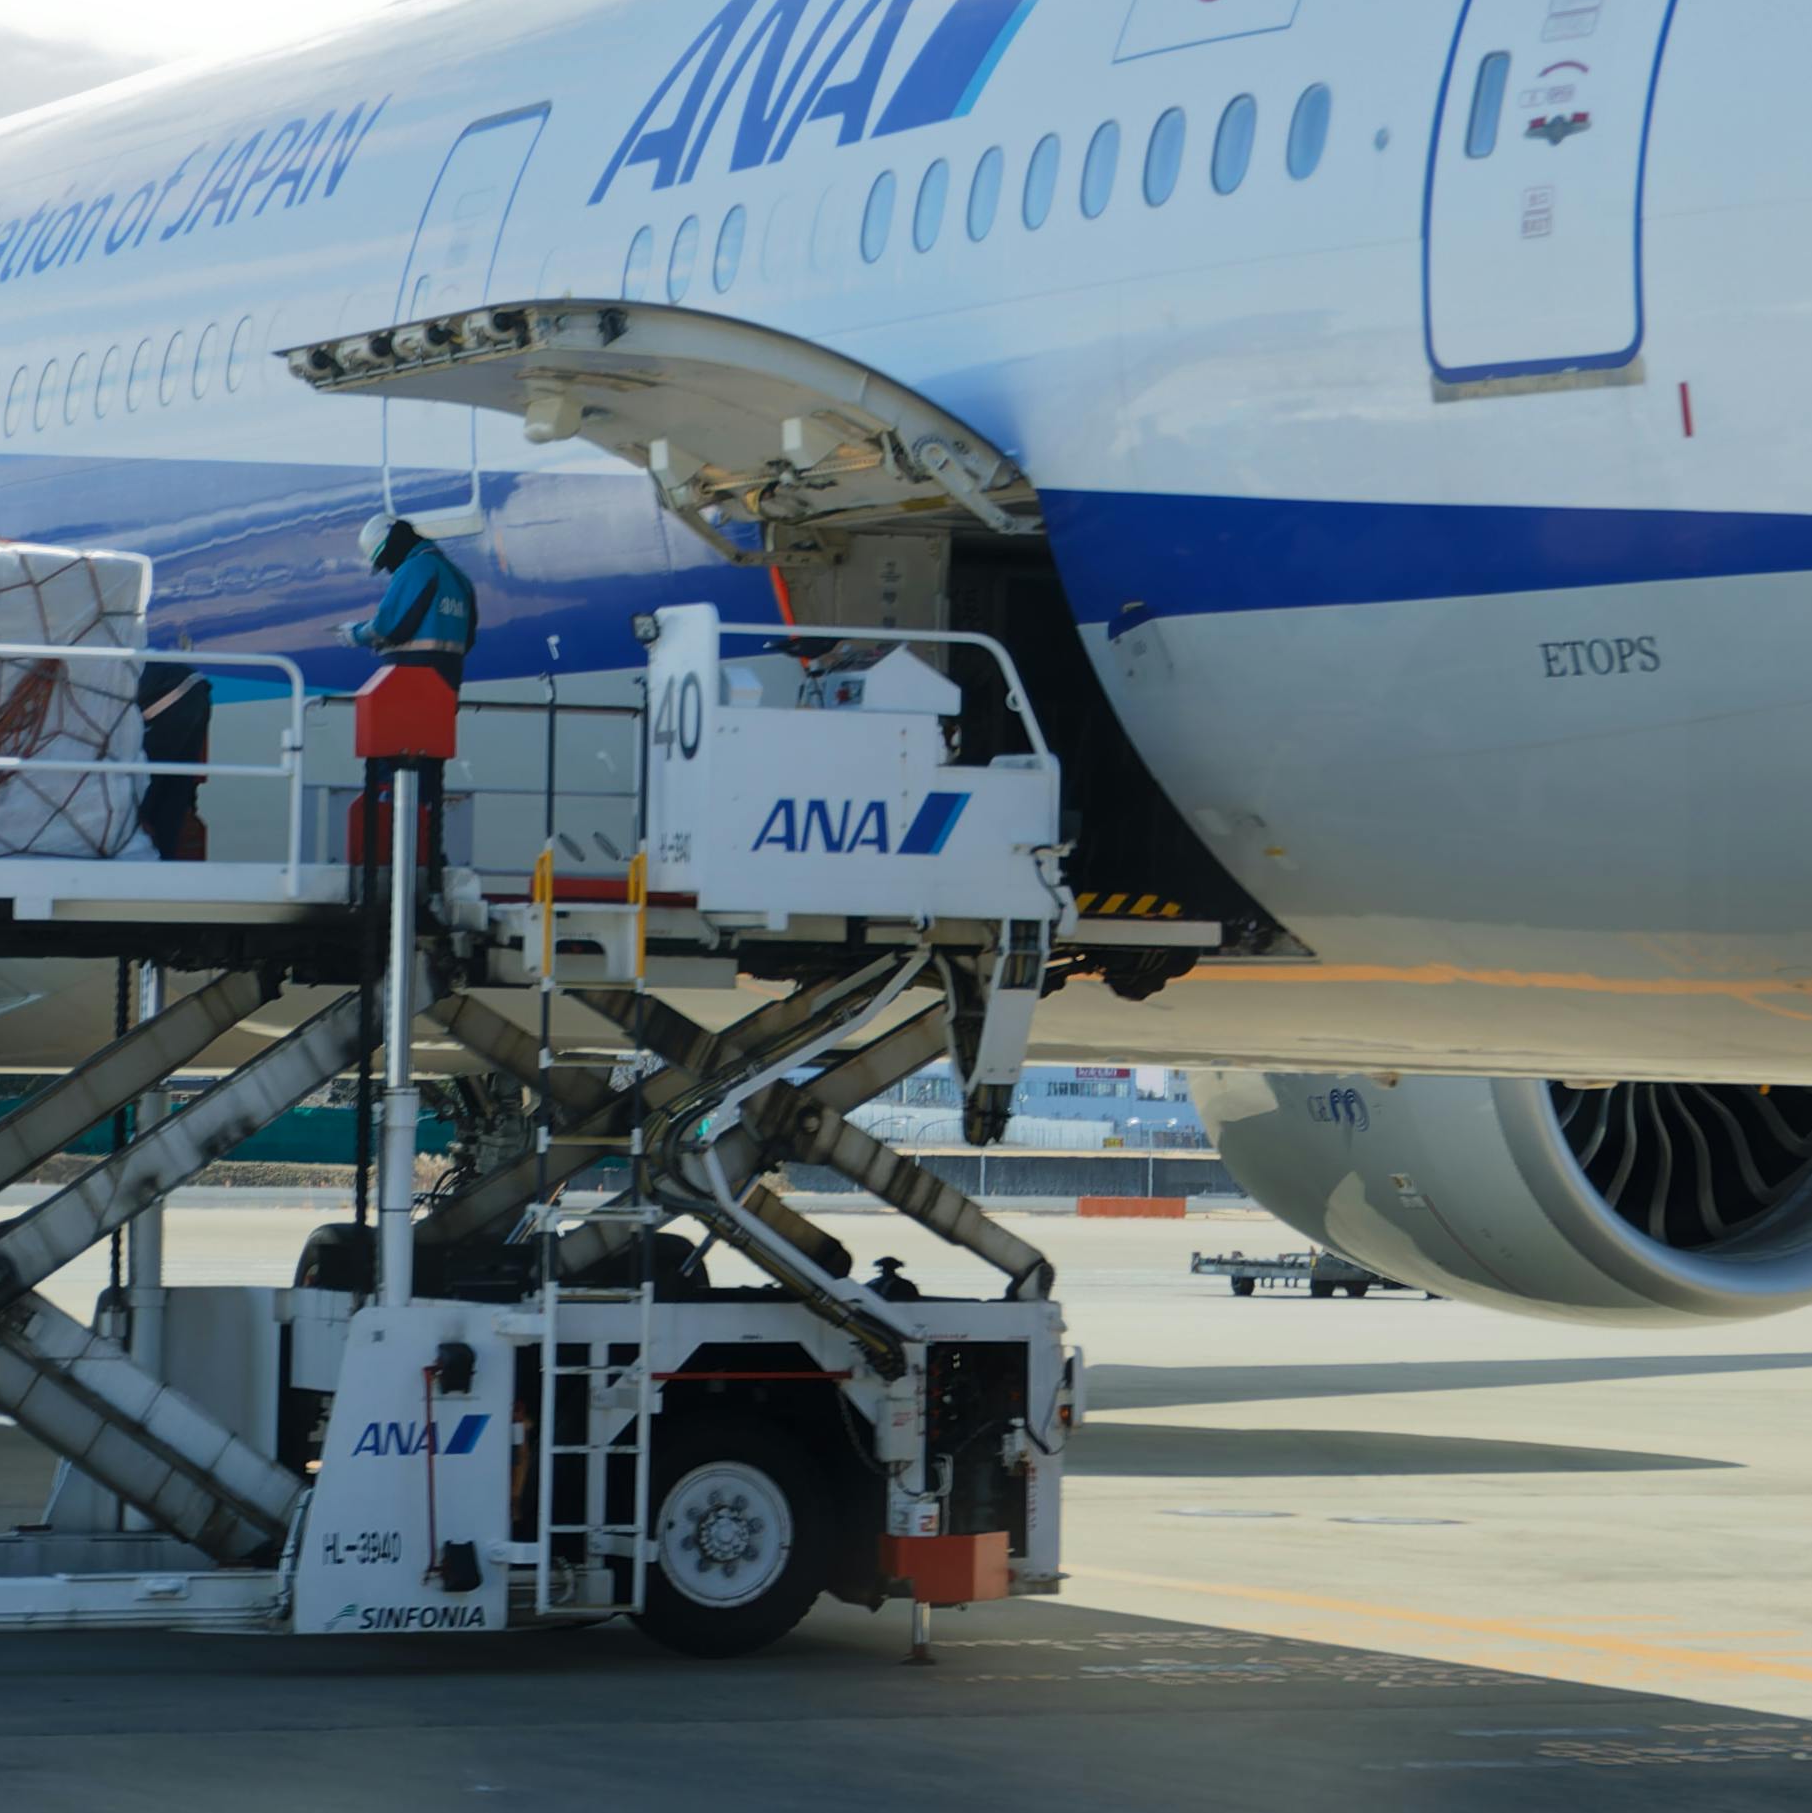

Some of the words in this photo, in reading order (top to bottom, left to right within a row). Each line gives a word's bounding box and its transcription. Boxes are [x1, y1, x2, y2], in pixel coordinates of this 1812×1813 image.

[103, 141, 209, 256] of
[160, 92, 394, 242] JAPAN
[1538, 636, 1662, 679] ETOPS
[653, 671, 702, 761] 40
[751, 799, 891, 852] ANA
[351, 1421, 439, 1456] ANA
[359, 1605, 486, 1631] SINFONIA
